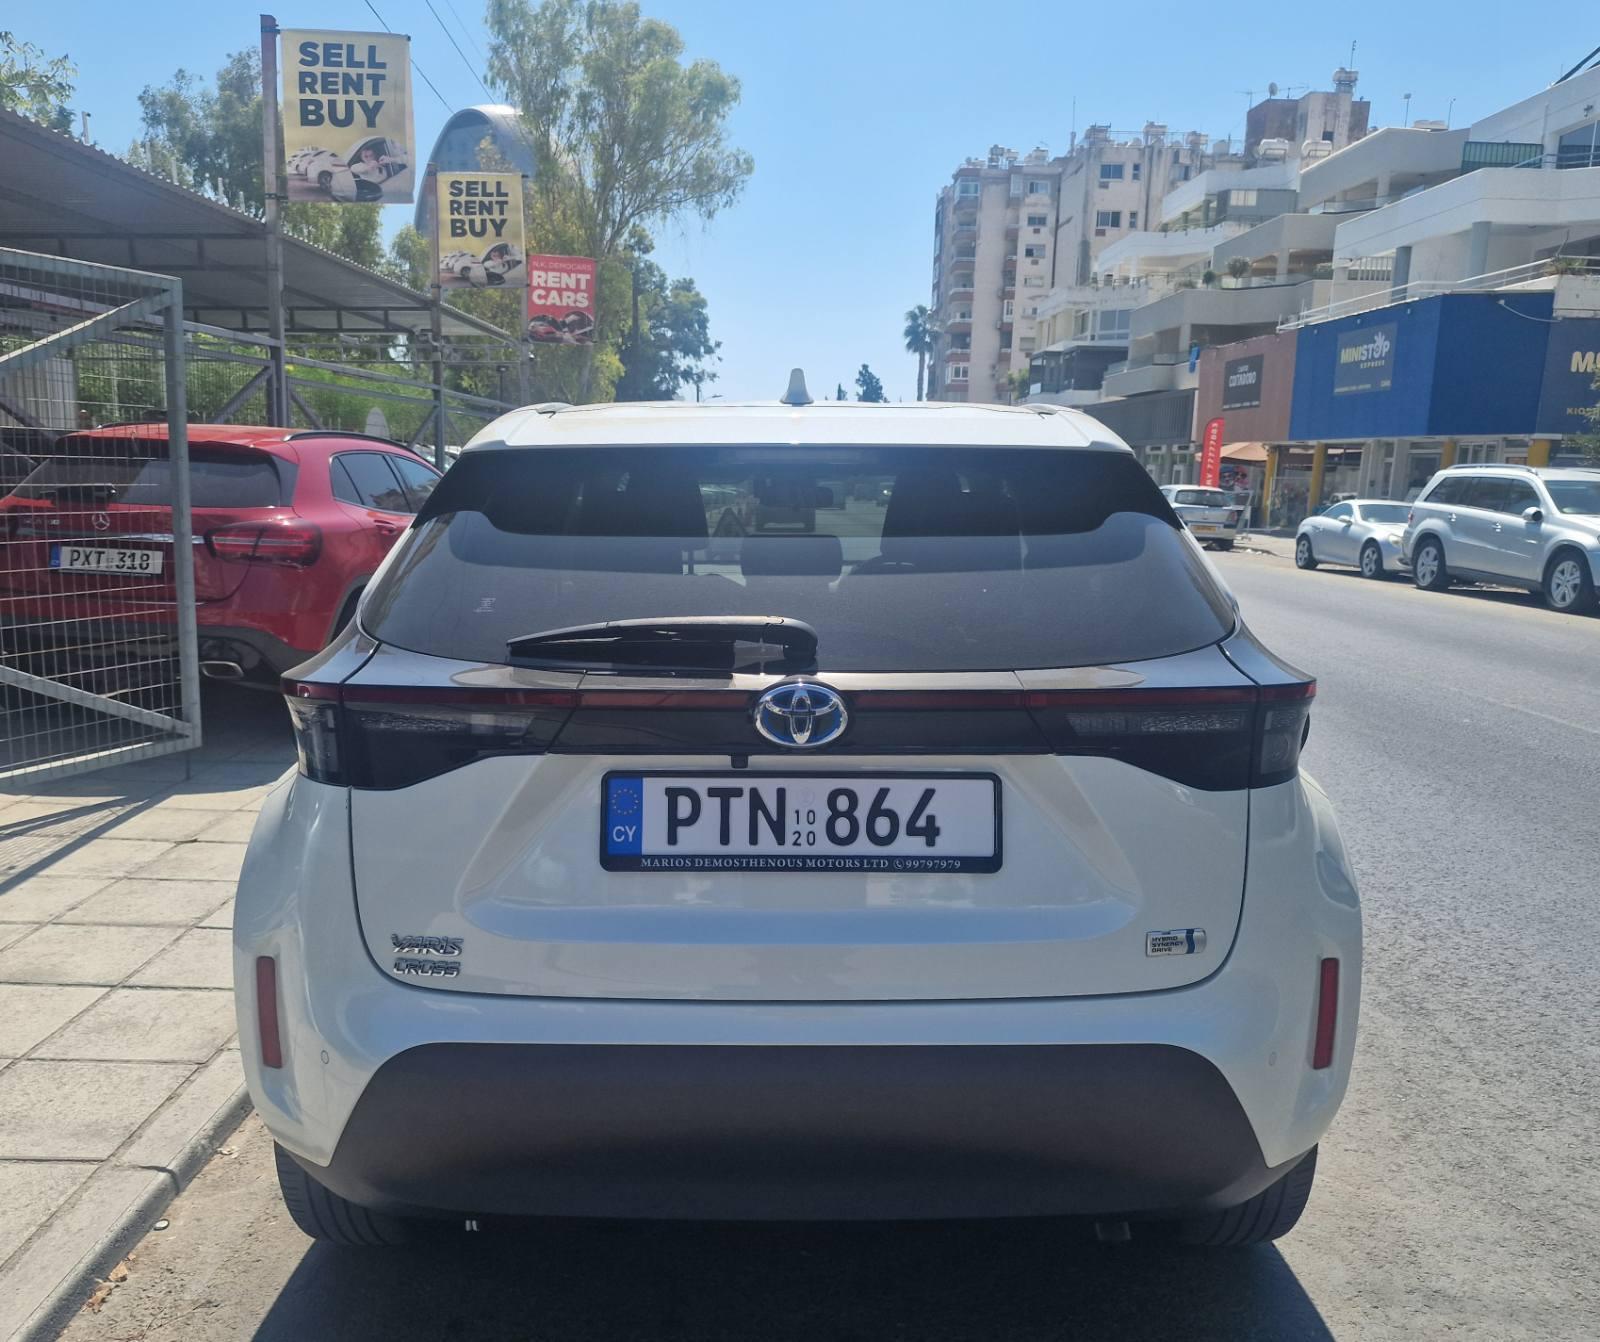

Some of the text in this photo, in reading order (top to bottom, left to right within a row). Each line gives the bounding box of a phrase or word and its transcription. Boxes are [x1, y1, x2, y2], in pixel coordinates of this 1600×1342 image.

[298, 41, 387, 70] SELL
[299, 71, 387, 96] RENT
[300, 99, 385, 129] BUY
[450, 180, 509, 198] SELL
[450, 200, 508, 216] RENT
[450, 218, 508, 238] BUY
[532, 270, 591, 290] RENT
[532, 289, 589, 308] CARS
[1340, 338, 1390, 364] MINISTOP
[69, 549, 106, 568] PXT
[115, 551, 150, 571] 318
[665, 787, 940, 847] PTN 864
[795, 809, 816, 825] 10
[612, 826, 636, 843] CY
[792, 830, 816, 846] 20
[641, 857, 961, 869] MARIOS DEMOSTHENOUS MOTORS LTD 99797979
[391, 933, 464, 957] YARIS
[393, 957, 461, 978] CROSS
